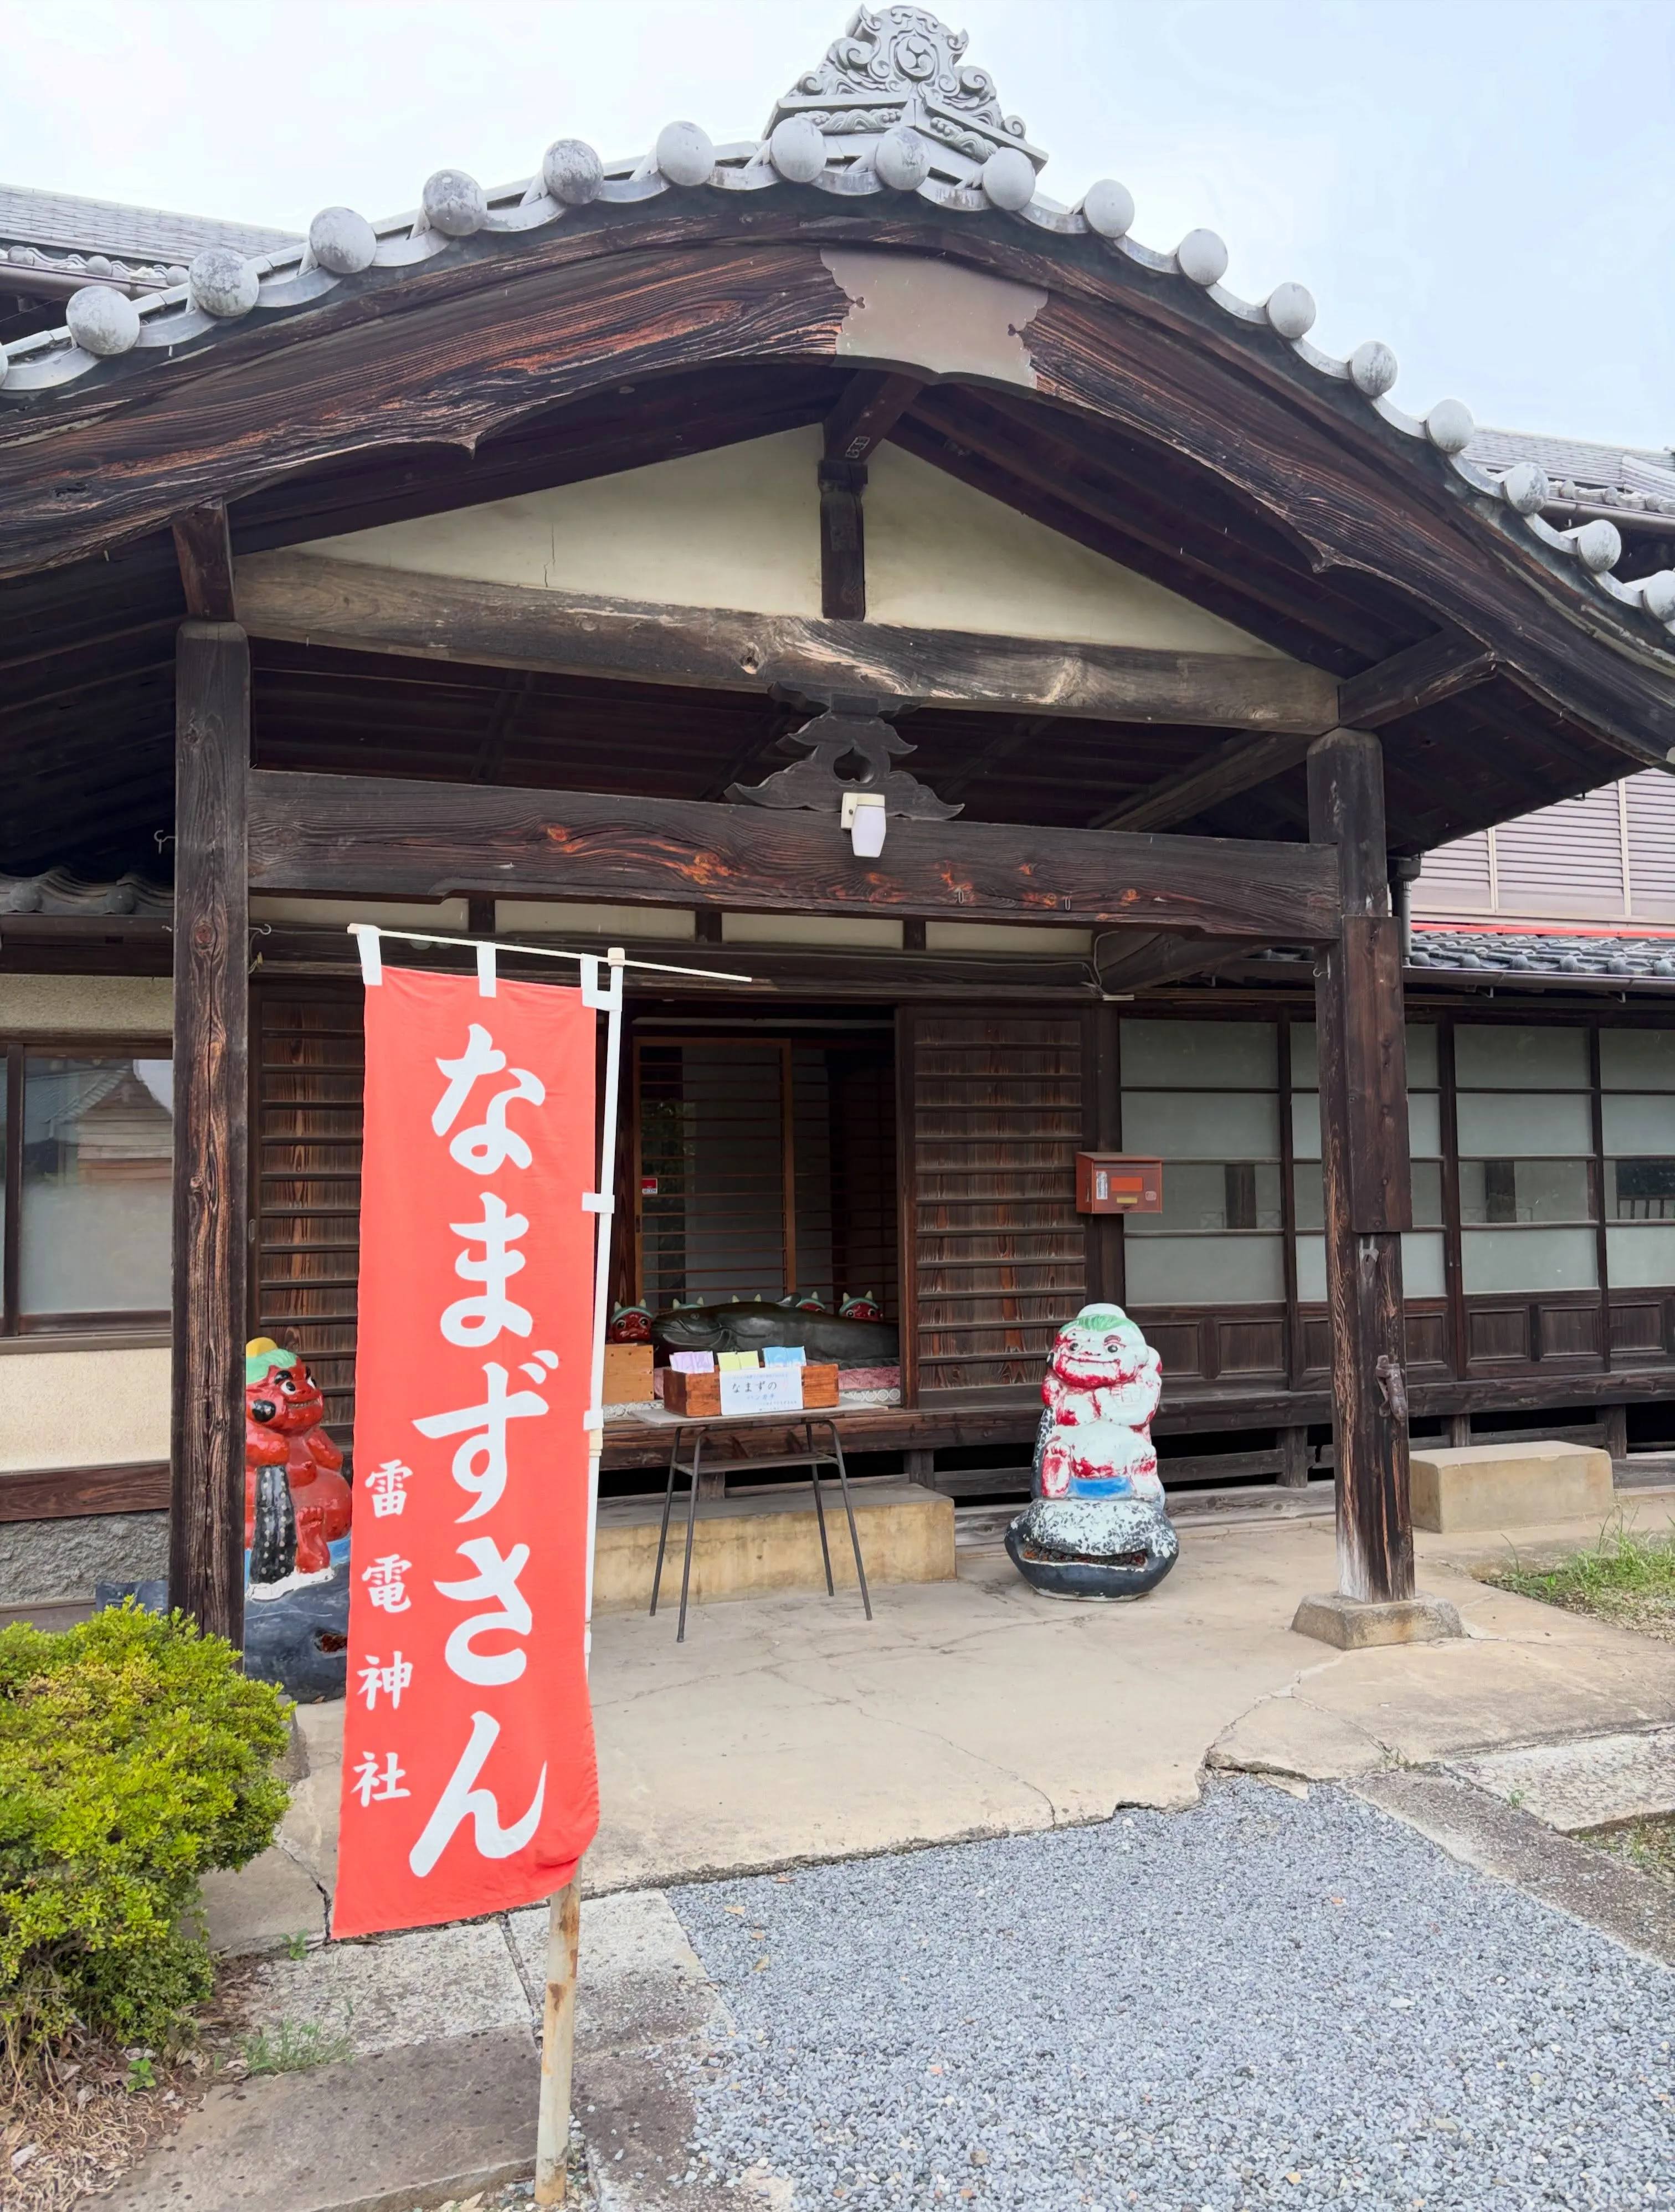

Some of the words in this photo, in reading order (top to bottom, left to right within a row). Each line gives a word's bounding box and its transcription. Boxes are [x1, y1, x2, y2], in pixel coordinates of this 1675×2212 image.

[409, 1023, 559, 1877] なまずさん
[732, 1381, 777, 1393] なまずの
[352, 1459, 413, 1807] 雷電神社
